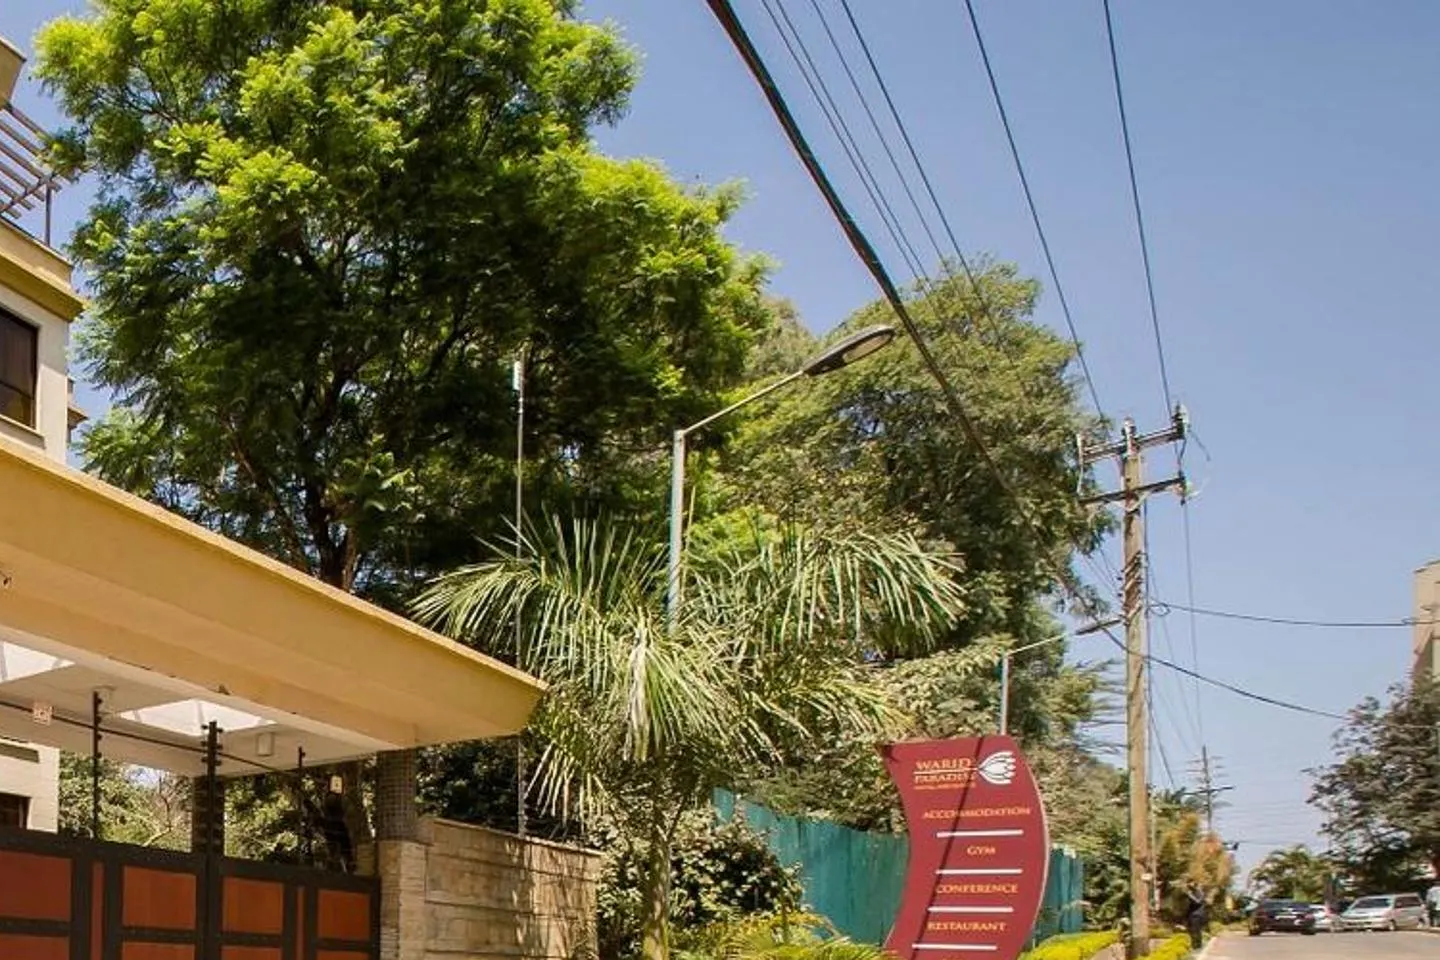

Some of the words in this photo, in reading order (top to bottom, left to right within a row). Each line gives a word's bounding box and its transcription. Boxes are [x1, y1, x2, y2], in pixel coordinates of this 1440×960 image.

[915, 758, 974, 771] WARID
[967, 847, 996, 855] GYM
[936, 884, 1018, 893] CONFERENCE
[927, 922, 1006, 931] RESTAURANT
